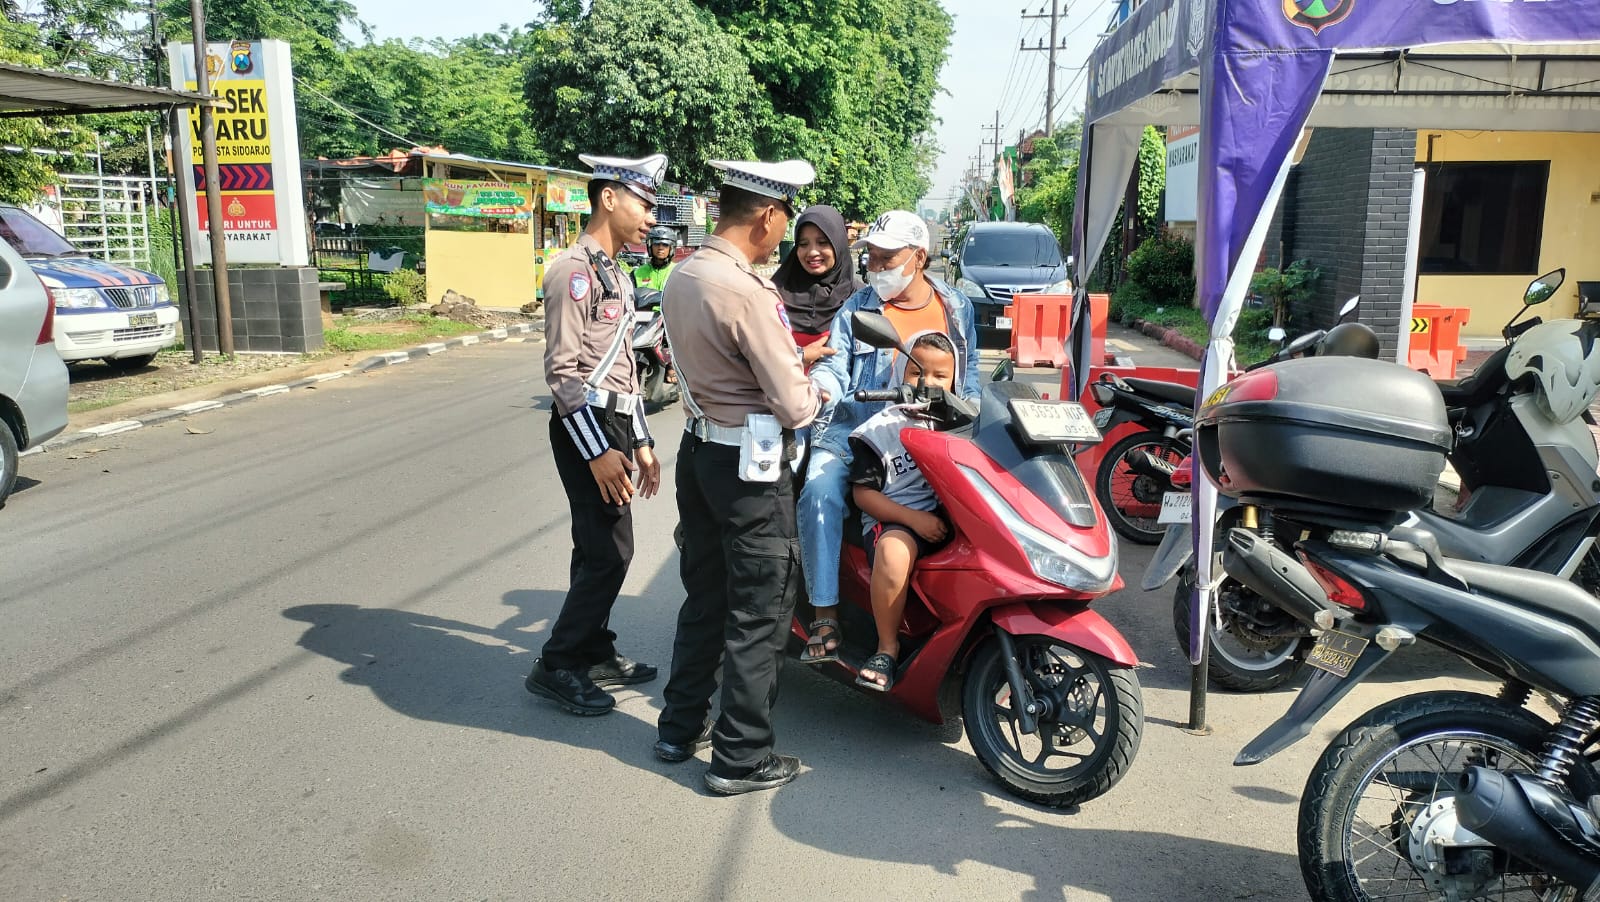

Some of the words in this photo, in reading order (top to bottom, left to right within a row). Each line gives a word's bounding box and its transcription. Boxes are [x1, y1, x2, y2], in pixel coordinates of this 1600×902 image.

[191, 88, 265, 114] LSEK
[193, 146, 231, 157] POSTA
[232, 145, 271, 156] SIDOARJO
[237, 220, 271, 229] UNTUK
